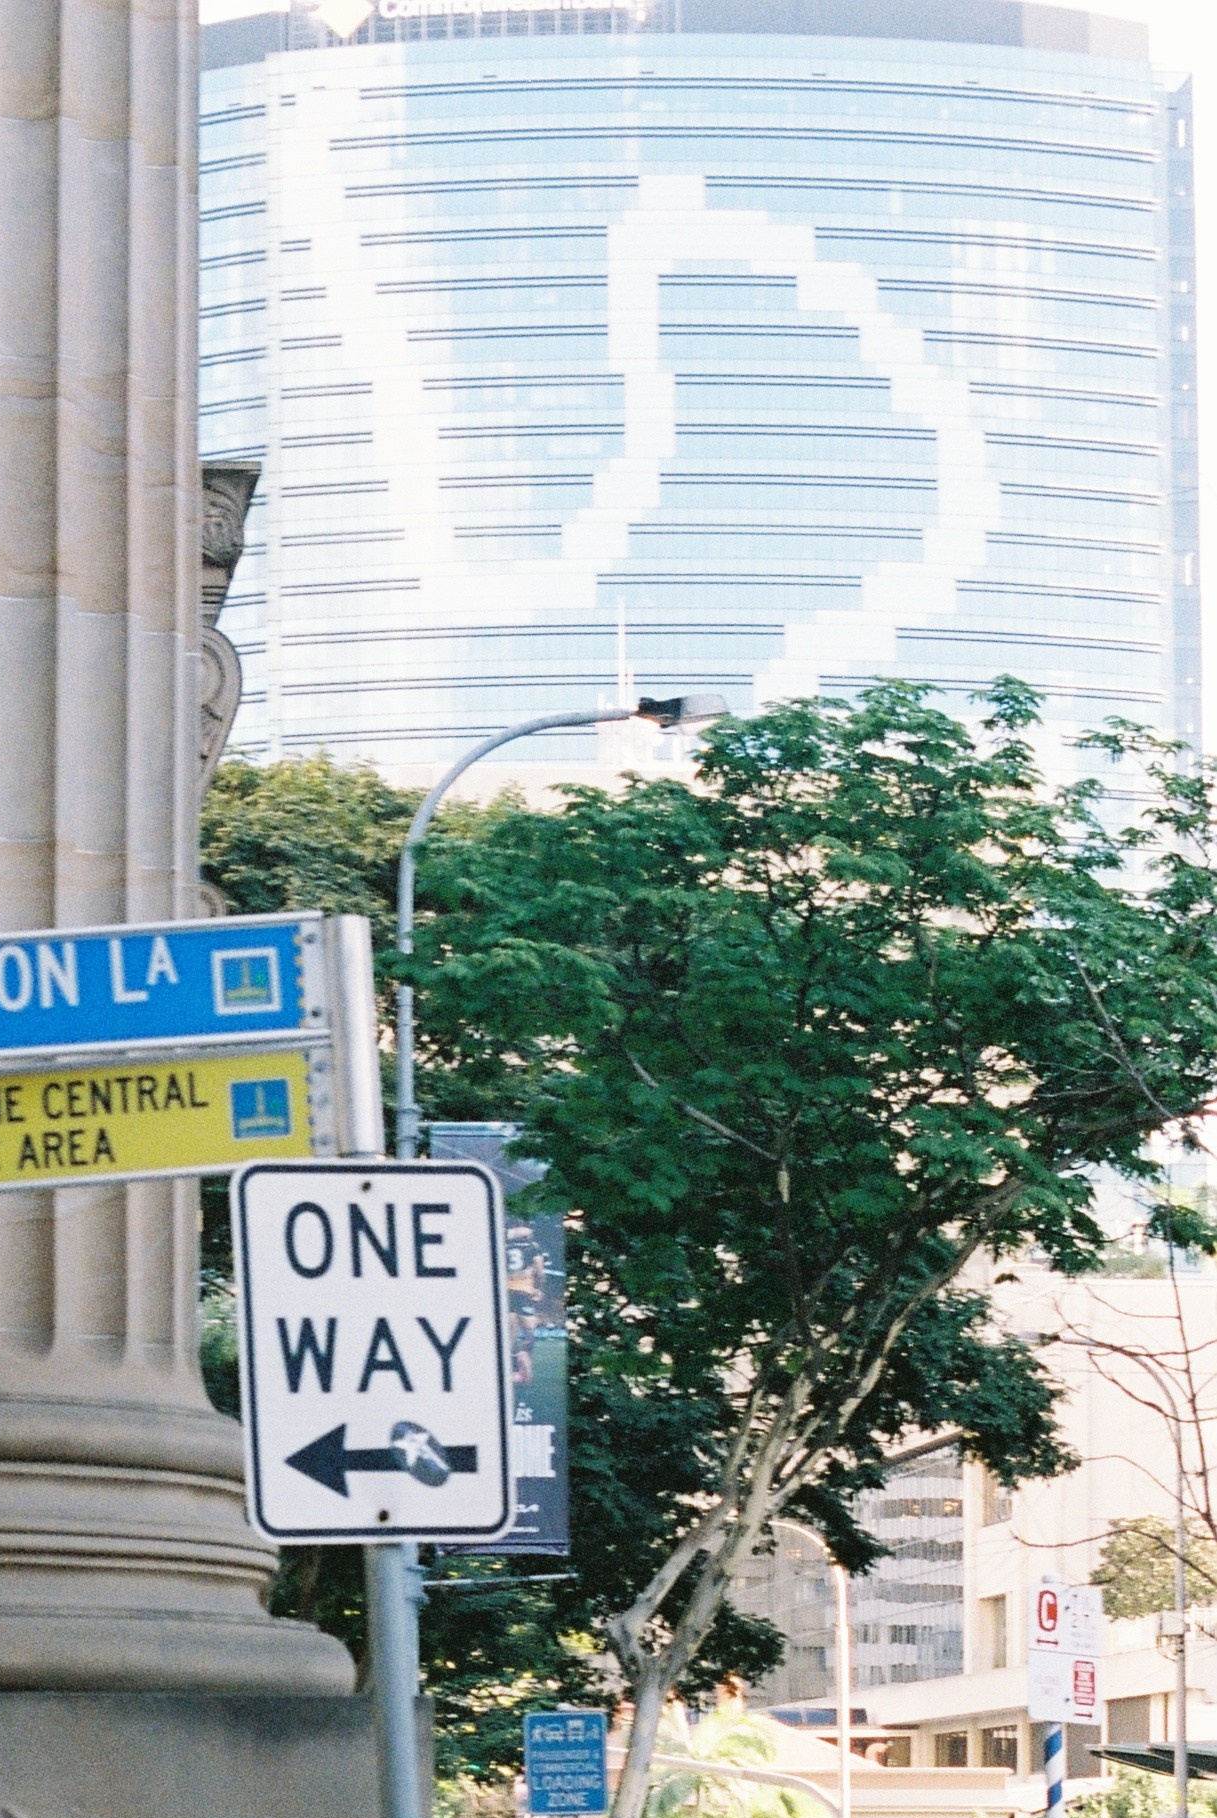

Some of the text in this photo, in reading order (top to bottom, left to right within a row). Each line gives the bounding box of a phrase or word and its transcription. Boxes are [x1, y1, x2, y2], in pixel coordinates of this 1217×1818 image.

[110, 936, 178, 1003] LA
[41, 1071, 209, 1121] CENTRAL
[18, 1128, 116, 1171] AREA
[285, 1201, 456, 1279] ONE
[277, 1317, 470, 1393] WAY
[531, 1774, 602, 1790] LOADING
[547, 1791, 590, 1807] ZONE
